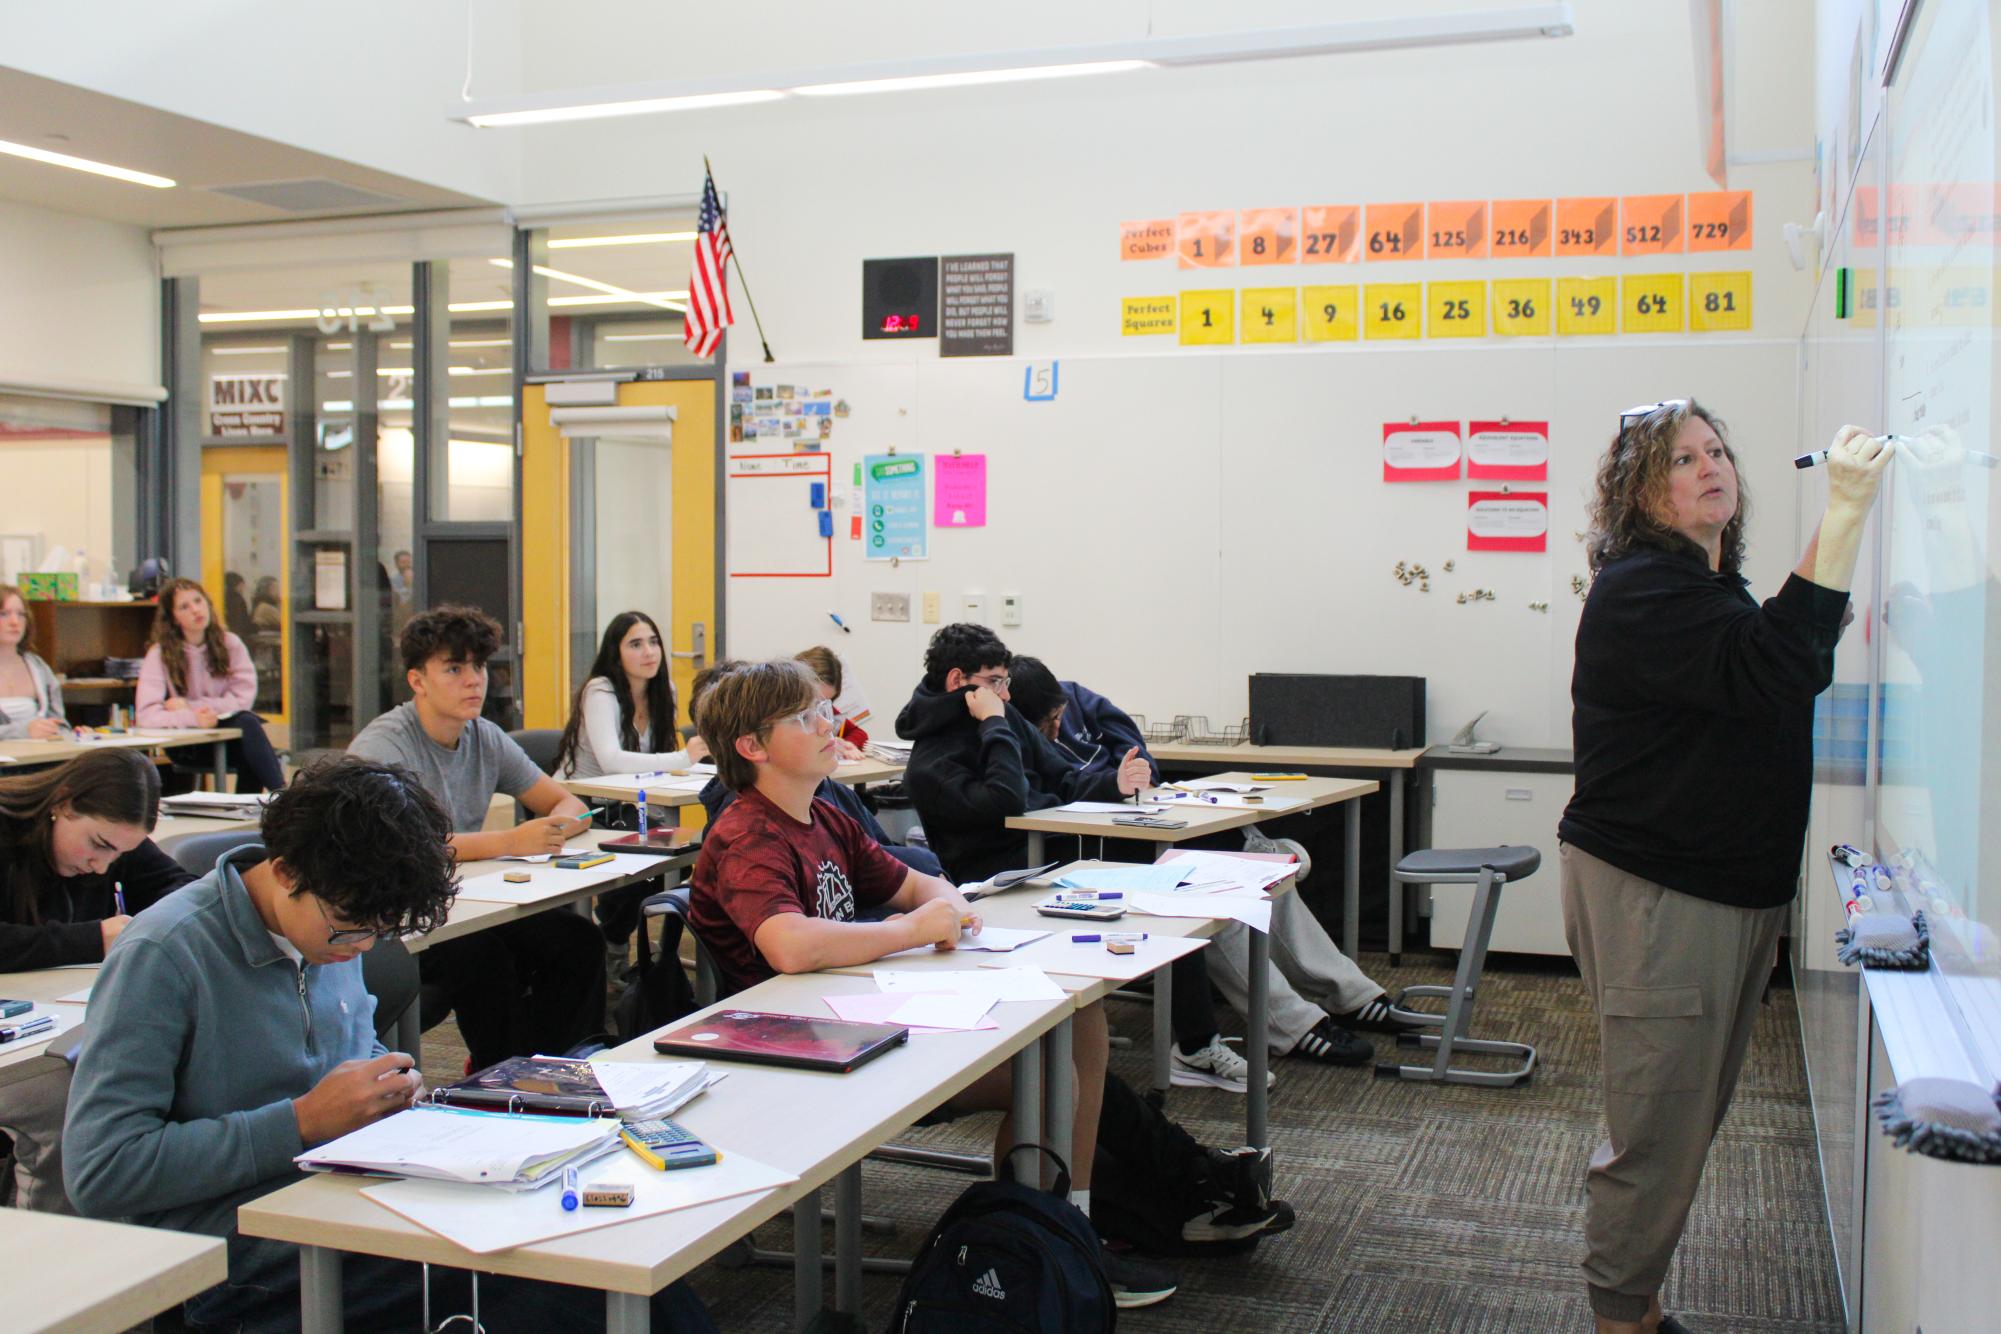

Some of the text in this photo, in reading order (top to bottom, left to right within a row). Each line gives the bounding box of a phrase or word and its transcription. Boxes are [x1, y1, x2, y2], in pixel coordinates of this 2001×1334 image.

[1432, 231, 1466, 247] 125
[1495, 229, 1529, 246] 216
[1560, 228, 1595, 246] 343
[1626, 226, 1662, 243] 512
[1692, 222, 1728, 239] 729
[1129, 243, 1168, 253] Cubes
[1193, 239, 1204, 257] 1
[1253, 236, 1266, 255] 8
[1305, 233, 1337, 255] 27
[1369, 231, 1401, 253] 64
[1127, 304, 1171, 314] Perfect
[1443, 300, 1470, 320] 25
[1507, 299, 1535, 318] 36
[1570, 296, 1601, 317] 49
[1637, 293, 1666, 314] 64
[1704, 291, 1736, 312] 81
[1202, 308, 1213, 327] 1
[1262, 306, 1274, 325] 4
[1324, 304, 1337, 323] 9
[1380, 302, 1406, 321] 16
[1125, 318, 1173, 330] Squares
[214, 379, 279, 405] MIXC
[972, 1283, 1005, 1299] adidas
